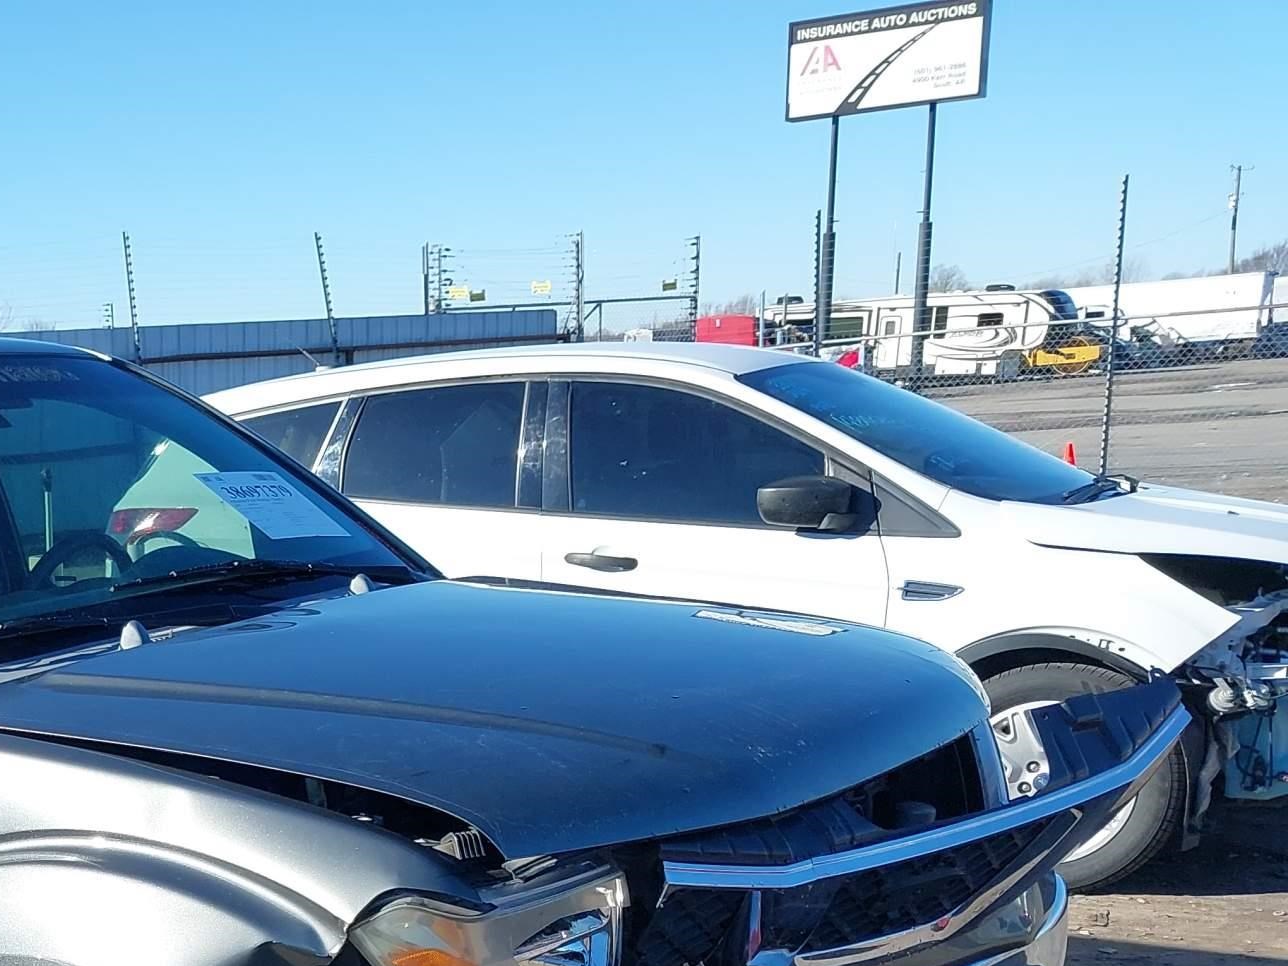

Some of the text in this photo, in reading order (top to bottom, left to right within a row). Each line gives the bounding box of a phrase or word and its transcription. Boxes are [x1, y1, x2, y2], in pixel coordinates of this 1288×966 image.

[796, 2, 977, 41] INSURANCE AUTO AUCTIONS
[220, 485, 294, 499] 38697379
